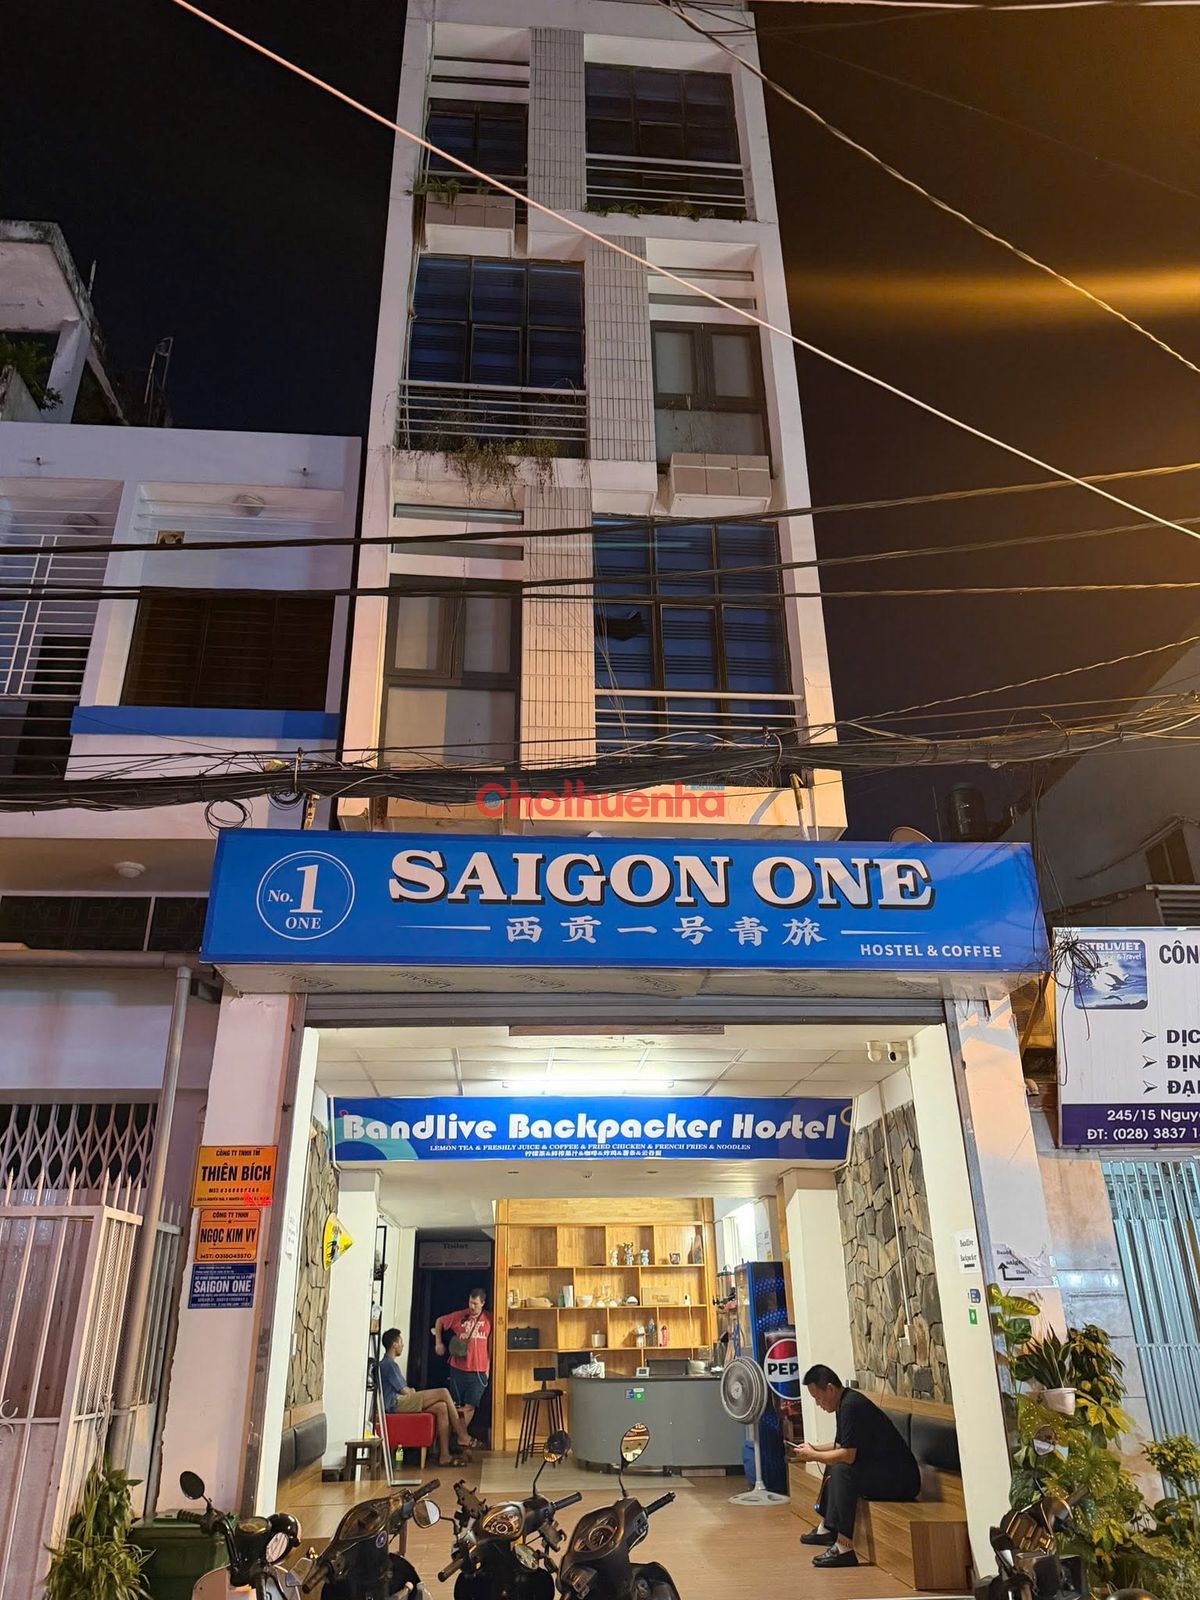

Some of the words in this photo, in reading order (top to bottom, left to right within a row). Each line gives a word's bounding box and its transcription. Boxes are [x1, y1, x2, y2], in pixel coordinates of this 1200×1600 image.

[389, 849, 731, 907] SAIGON
[752, 856, 936, 909] ONE
[267, 889, 293, 903] No.
[289, 864, 323, 913] 1
[285, 916, 321, 930] ONE
[505, 914, 828, 947] 西贡一号青旅
[860, 944, 923, 957] HOSTEL
[927, 945, 938, 957] &
[941, 945, 1002, 958] COFFEE
[1107, 1109, 1156, 1122] 245/15
[1160, 1109, 1200, 1123] Nguy
[343, 1113, 497, 1139] Bandlive
[508, 1113, 722, 1143] Backpacker
[732, 1113, 836, 1139] Hostel
[1087, 1128, 1108, 1140] ĐT:
[1113, 1128, 1149, 1140] (028)
[1153, 1127, 1187, 1139] 3837
[201, 1162, 238, 1182] THIÊN
[241, 1162, 271, 1182] BÍCH
[200, 1228, 224, 1246] NGỌC
[226, 1228, 243, 1243] KIM
[245, 1228, 256, 1243] VY
[194, 1280, 230, 1293] SAIGON
[232, 1280, 252, 1293] ONE
